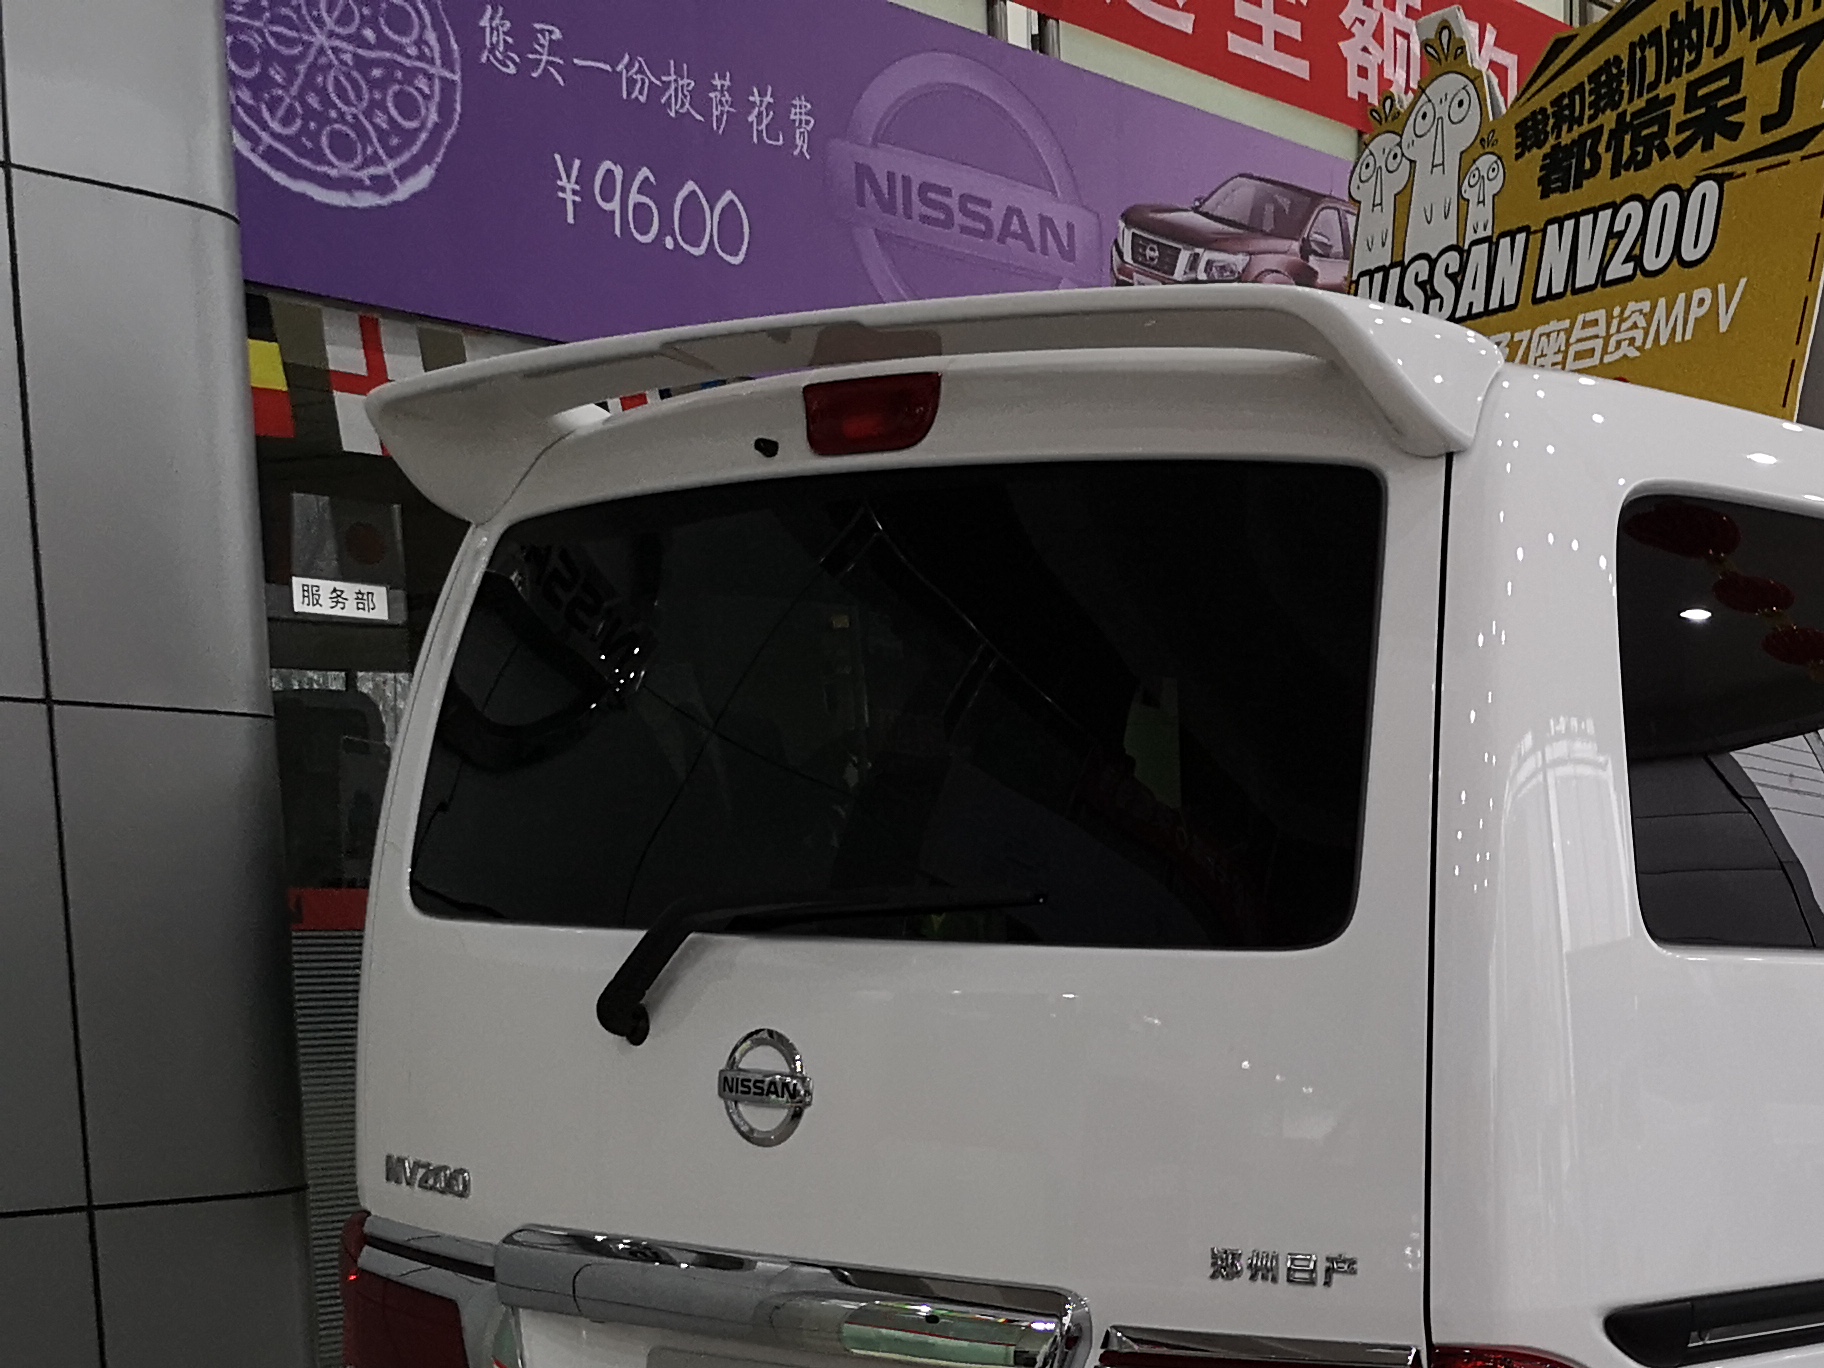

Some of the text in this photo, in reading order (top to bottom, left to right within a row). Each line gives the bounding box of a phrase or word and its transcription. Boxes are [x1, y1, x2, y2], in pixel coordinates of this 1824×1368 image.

[477, 3, 816, 160] 您买一份披萨花费
[553, 153, 751, 265] ¥96.00
[853, 159, 1078, 264] NISSAN
[1535, 179, 1722, 302] NV200
[301, 583, 376, 614] 服务部
[722, 1076, 799, 1102] NISSAN
[384, 1153, 472, 1199] NV200
[1208, 1246, 1359, 1288] 郑州日产
